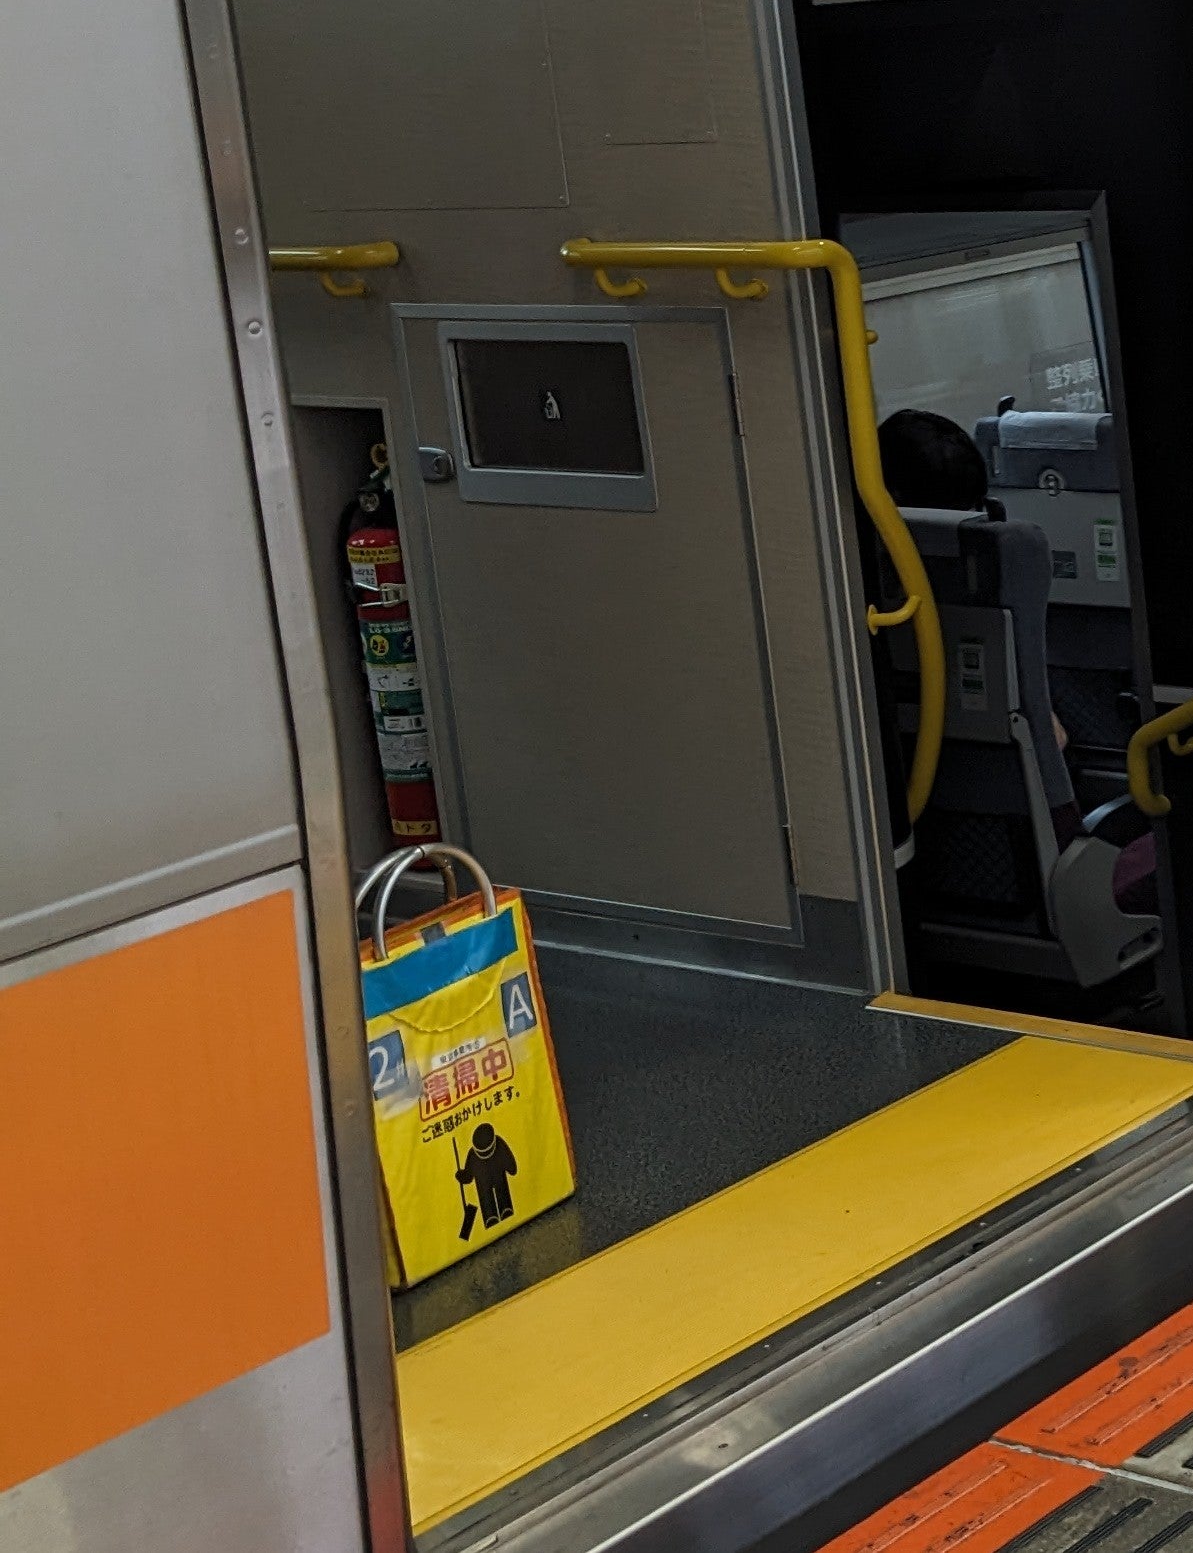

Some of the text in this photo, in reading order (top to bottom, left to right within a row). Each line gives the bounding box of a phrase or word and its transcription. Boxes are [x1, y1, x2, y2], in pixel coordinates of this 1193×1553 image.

[508, 983, 533, 1030] A
[368, 1045, 395, 1092] 2
[423, 1048, 507, 1115] 清掃中
[421, 1085, 521, 1143] ご迷惑おかけします。
